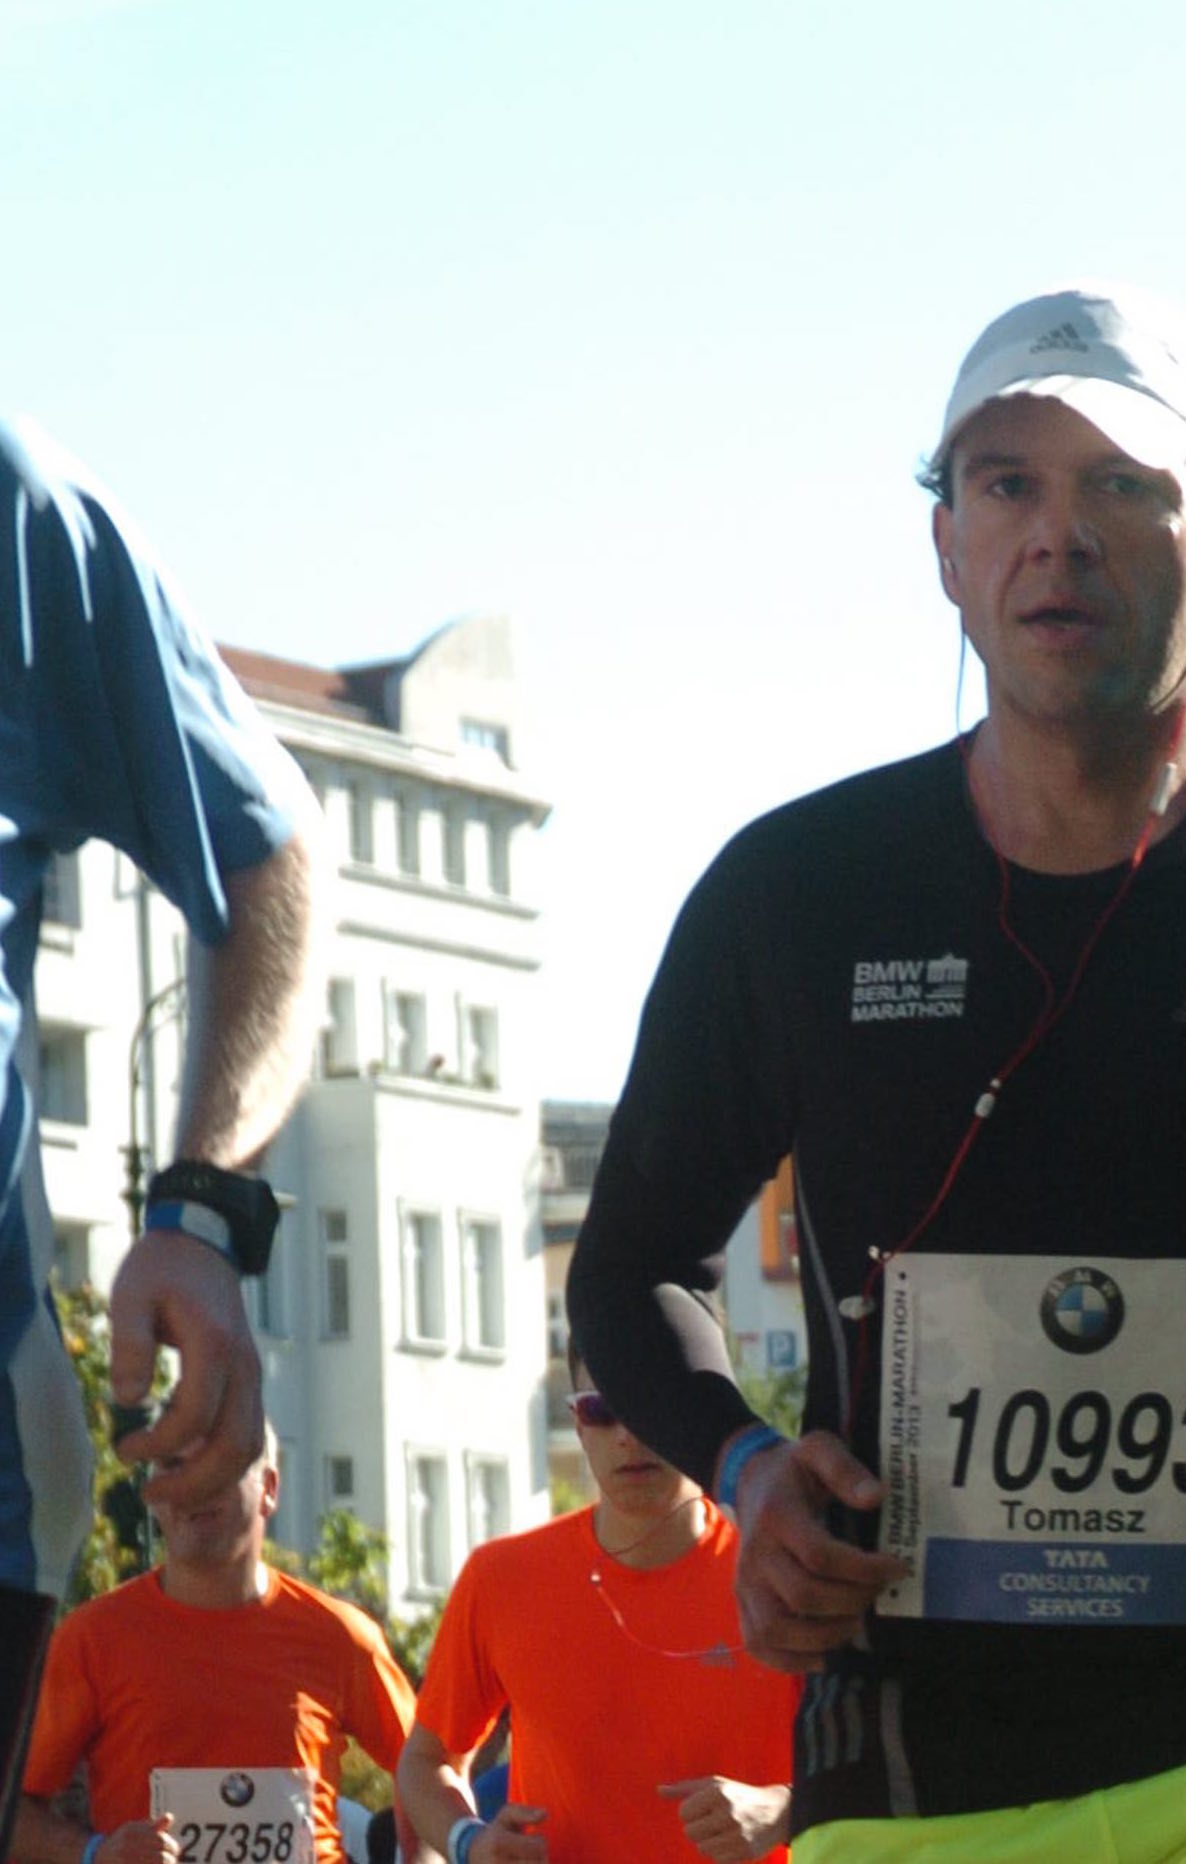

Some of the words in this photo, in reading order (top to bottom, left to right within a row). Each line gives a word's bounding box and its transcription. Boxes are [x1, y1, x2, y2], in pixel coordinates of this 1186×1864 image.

[854, 961, 923, 983] BMW
[853, 984, 922, 1003] BERLIN
[851, 1002, 964, 1021] MARATHON
[1000, 1500, 1146, 1533] Tomasz
[1044, 1549, 1109, 1569] TATA
[1000, 1572, 1149, 1593] CONSULTANCY
[1027, 1599, 1124, 1617] SERVICES
[178, 1822, 294, 1864] 27358
